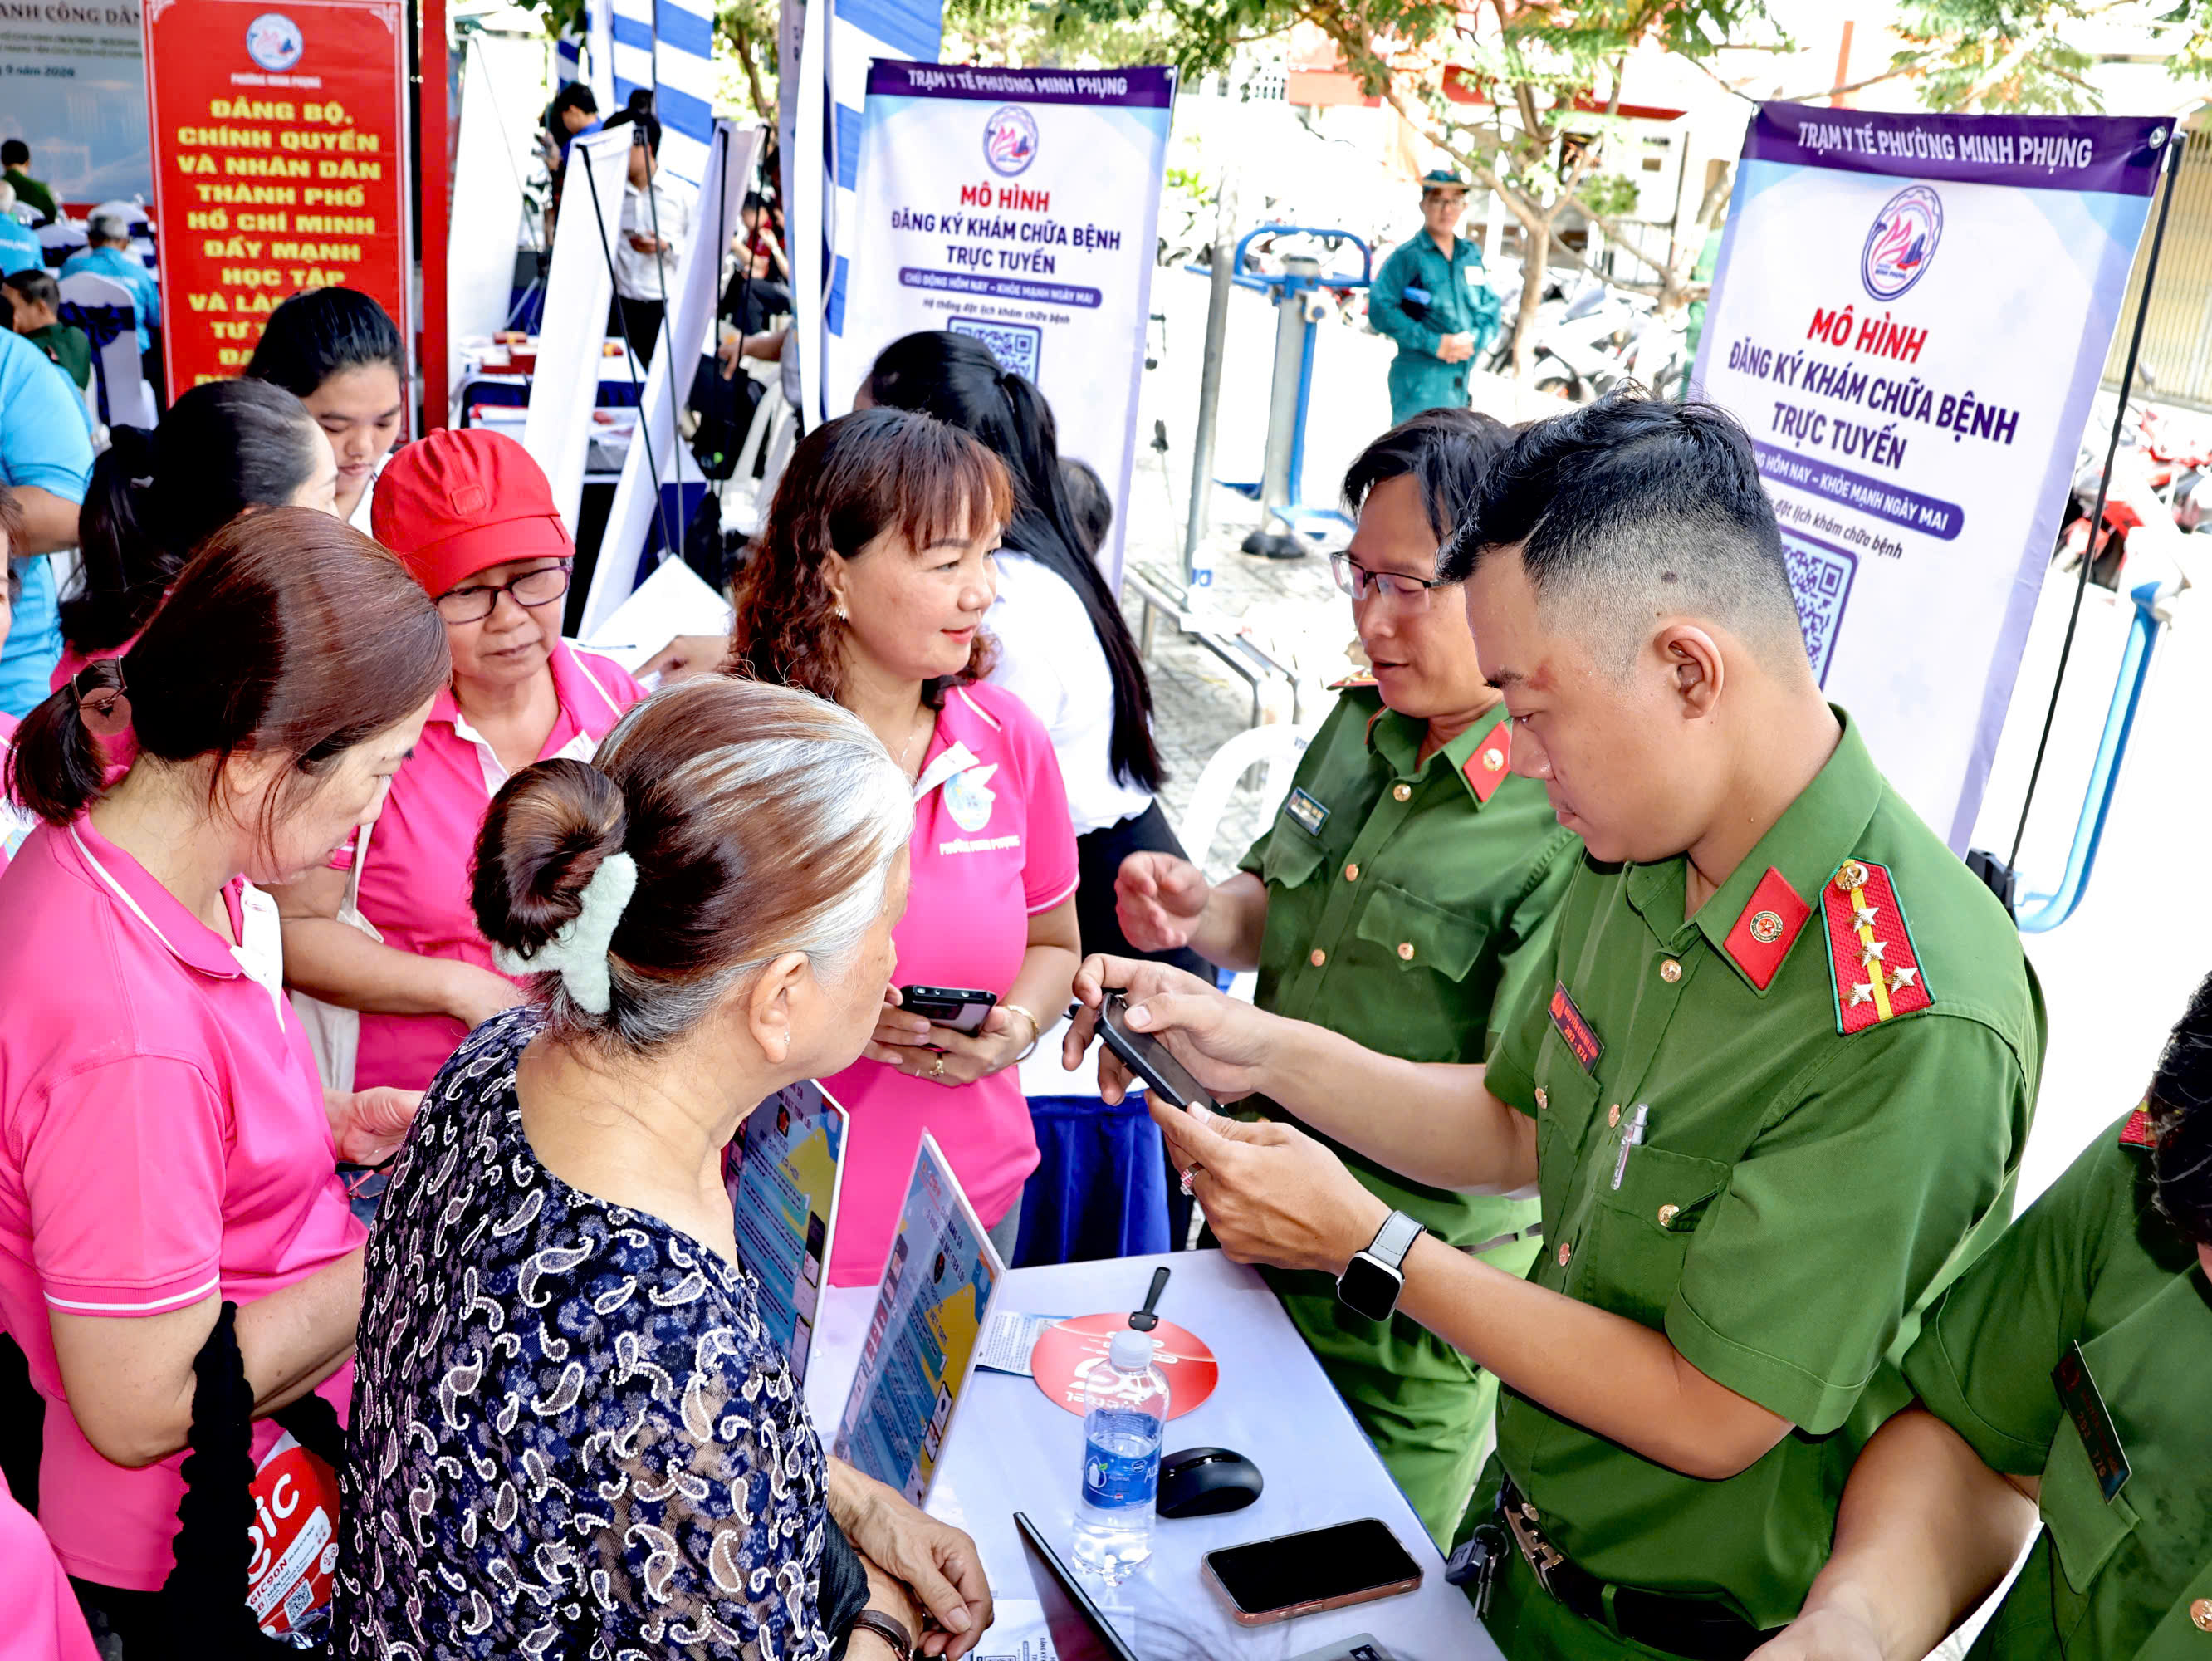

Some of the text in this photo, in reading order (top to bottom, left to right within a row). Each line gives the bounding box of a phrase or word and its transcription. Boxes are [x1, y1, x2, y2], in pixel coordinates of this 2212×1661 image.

[45, 1, 100, 22] CÔNG
[908, 69, 1128, 99] TRẠM Y TẾ PHƯỜNG MINH PHỤNG
[177, 125, 272, 149] CHÍNH
[1798, 121, 2094, 174] TRẠM Y TẾ PHƯỜNG MINH PHỤNG
[176, 153, 382, 179] VÀ NHÂN DÂN
[196, 182, 365, 208] THÀNH PHỐ
[960, 180, 1050, 213] MÔ HÌNH
[187, 208, 376, 235] HỒ CHÍ MINH
[892, 208, 1122, 252] ĐĂNG KÝ KHÁM CHỮA BỆNH
[272, 241, 361, 263] MẠNH
[947, 245, 1055, 274] TRỰC TUYẾN
[222, 267, 282, 289] HỌC
[970, 279, 990, 293] NAY
[1076, 290, 1094, 305] MAI
[188, 292, 228, 312] VÀ
[210, 321, 251, 340] TƯ
[1806, 304, 1929, 364] MÔ HÌNH
[1728, 336, 2020, 445] ĐĂNG KÝ KHÁM CHỮA BỆNH
[1771, 401, 1908, 471] TRỰC TUYẾN
[1765, 453, 1789, 477] HÔM
[1788, 463, 1813, 484] NAY
[1819, 473, 1851, 498] KHỎE
[1849, 484, 1883, 509] MẠNH
[1884, 495, 1918, 522] NGÀY
[1918, 510, 1950, 532] MAI
[1792, 507, 1812, 525] lịch
[1813, 512, 1843, 536] khám
[1843, 526, 1871, 548] chữa
[1871, 533, 1904, 559] bệnh
